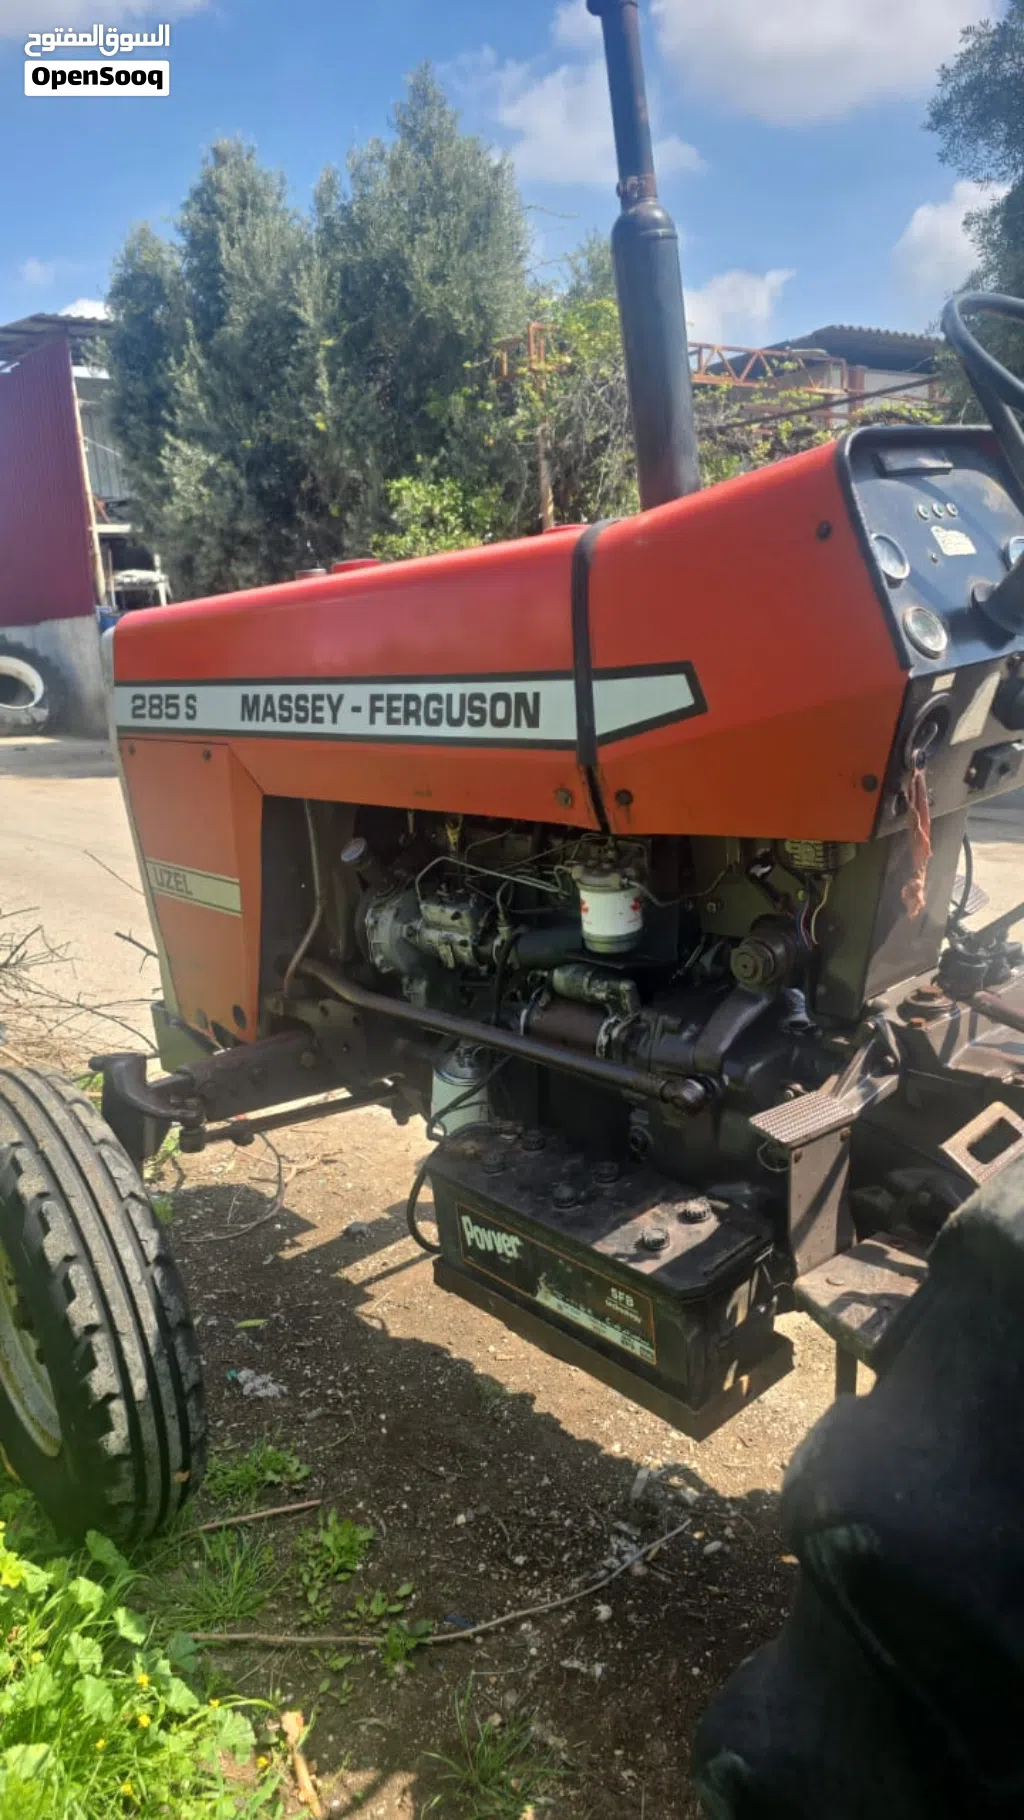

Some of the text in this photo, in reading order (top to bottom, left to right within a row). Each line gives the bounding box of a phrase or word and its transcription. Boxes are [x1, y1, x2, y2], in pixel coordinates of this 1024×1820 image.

[131, 694, 180, 720] 285
[240, 693, 345, 725] MASSEY
[369, 691, 541, 729] FERGUSON
[153, 864, 194, 896] UZEL
